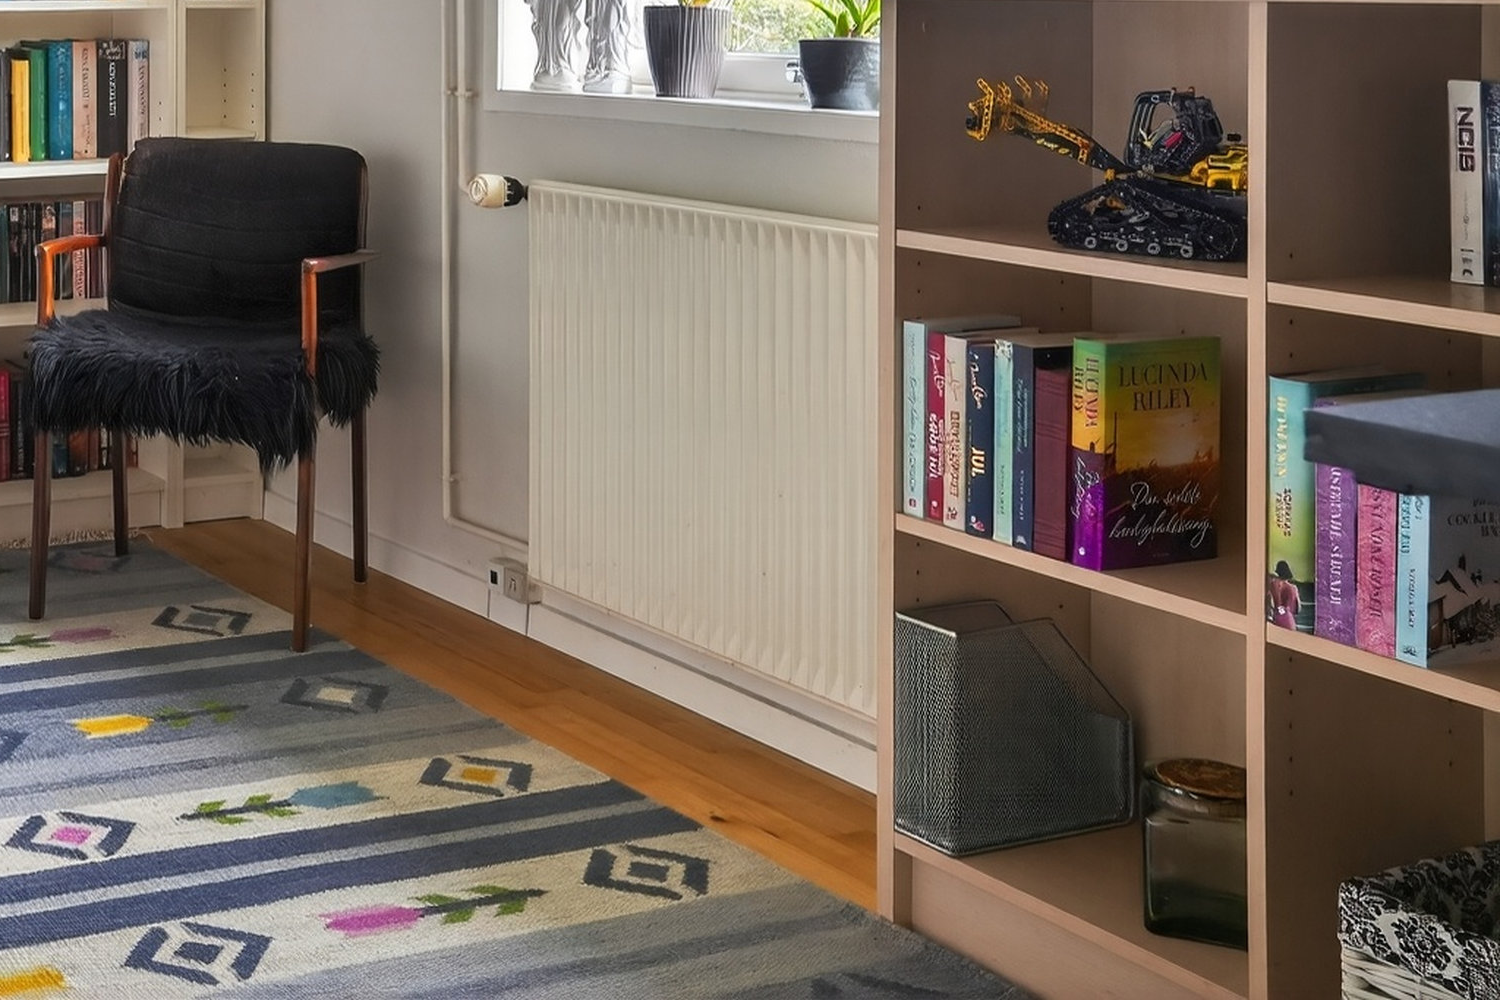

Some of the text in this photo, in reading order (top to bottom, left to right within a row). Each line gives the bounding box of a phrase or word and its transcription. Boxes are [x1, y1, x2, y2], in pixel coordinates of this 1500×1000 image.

[1456, 106, 1476, 173] NCIS
[1119, 361, 1209, 387] LUCINDA
[1133, 388, 1195, 411] RILEY
